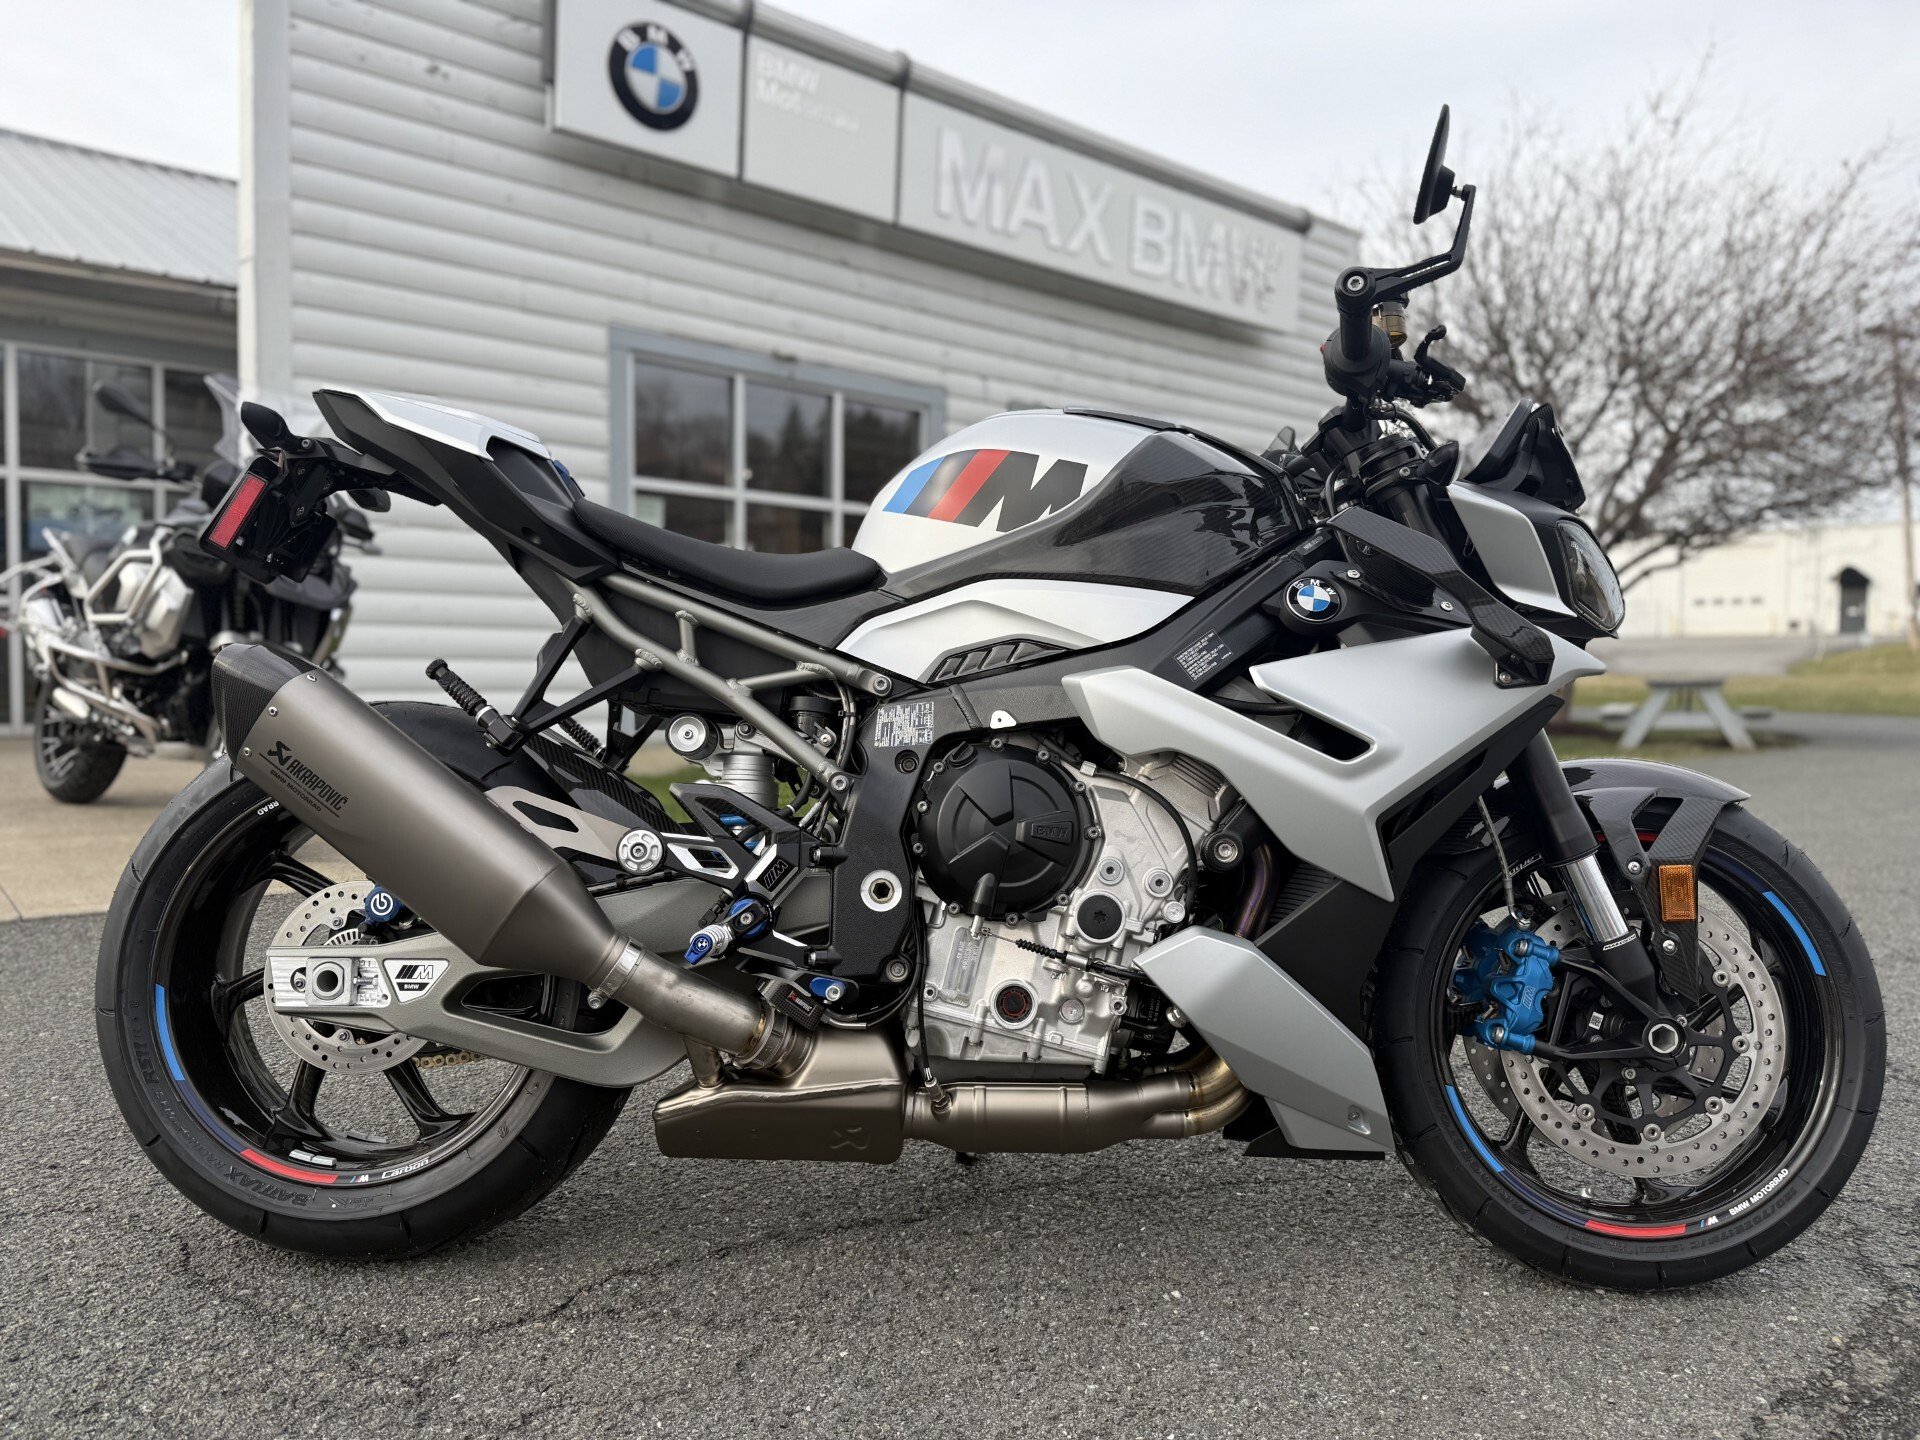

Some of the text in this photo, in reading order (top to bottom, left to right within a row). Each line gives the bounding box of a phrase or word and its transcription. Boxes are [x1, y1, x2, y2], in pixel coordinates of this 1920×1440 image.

[617, 24, 695, 72] BMW
[936, 127, 1112, 265] MAX
[1036, 825, 1069, 838] BMW
[380, 1156, 430, 1180] Carbon
[1728, 1200, 1751, 1216] BMW
[1749, 1167, 1790, 1205] MOTORRAD
